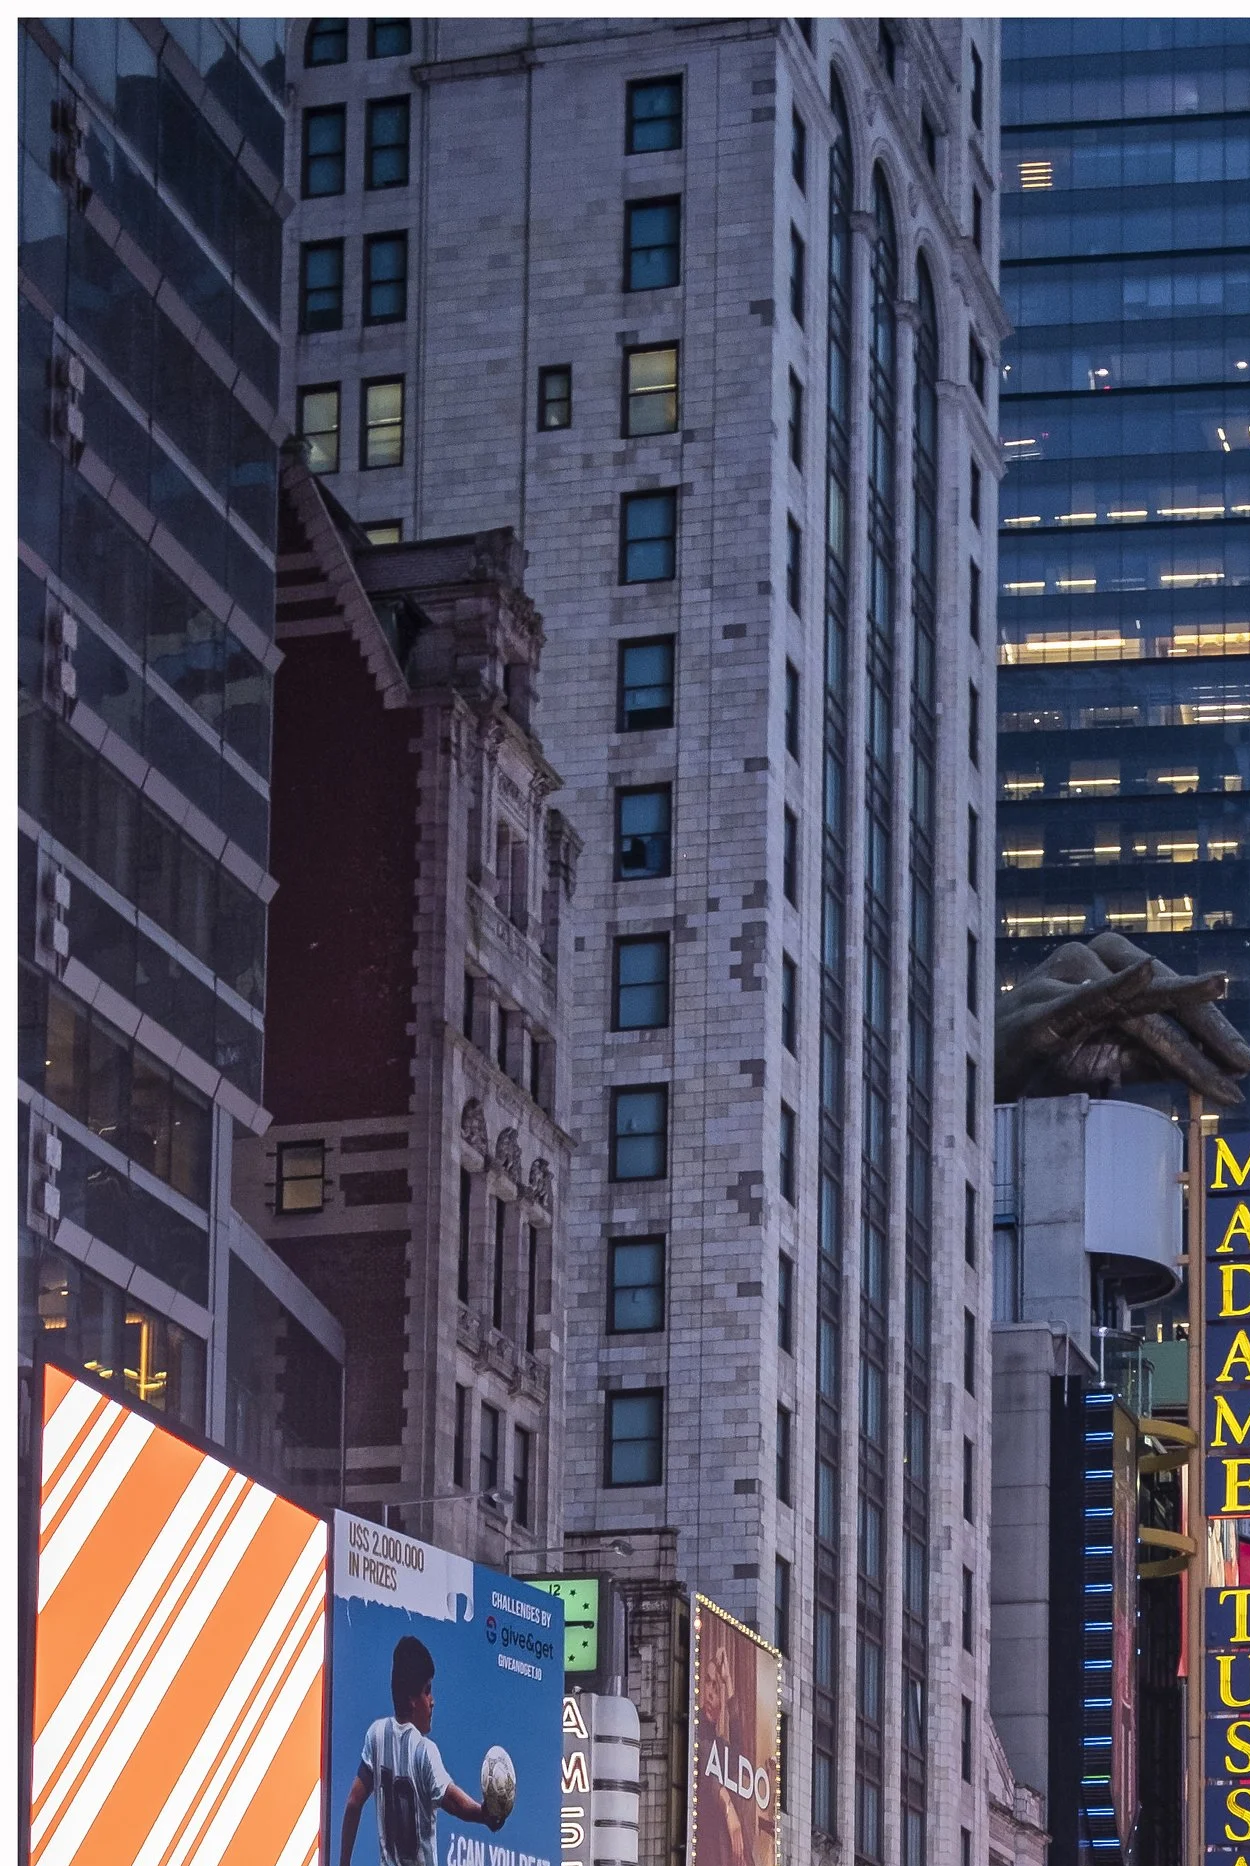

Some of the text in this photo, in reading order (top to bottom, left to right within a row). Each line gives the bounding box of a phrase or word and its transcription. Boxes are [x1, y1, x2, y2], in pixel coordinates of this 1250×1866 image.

[349, 1550, 398, 1592] IN PRIZES
[372, 1531, 425, 1573] 2.000.000
[491, 1591, 552, 1628] CHALLENGES BY
[501, 1624, 554, 1660] give&get
[498, 1653, 542, 1681] GIVEANDGET.IO
[705, 1738, 771, 1811] ALDO
